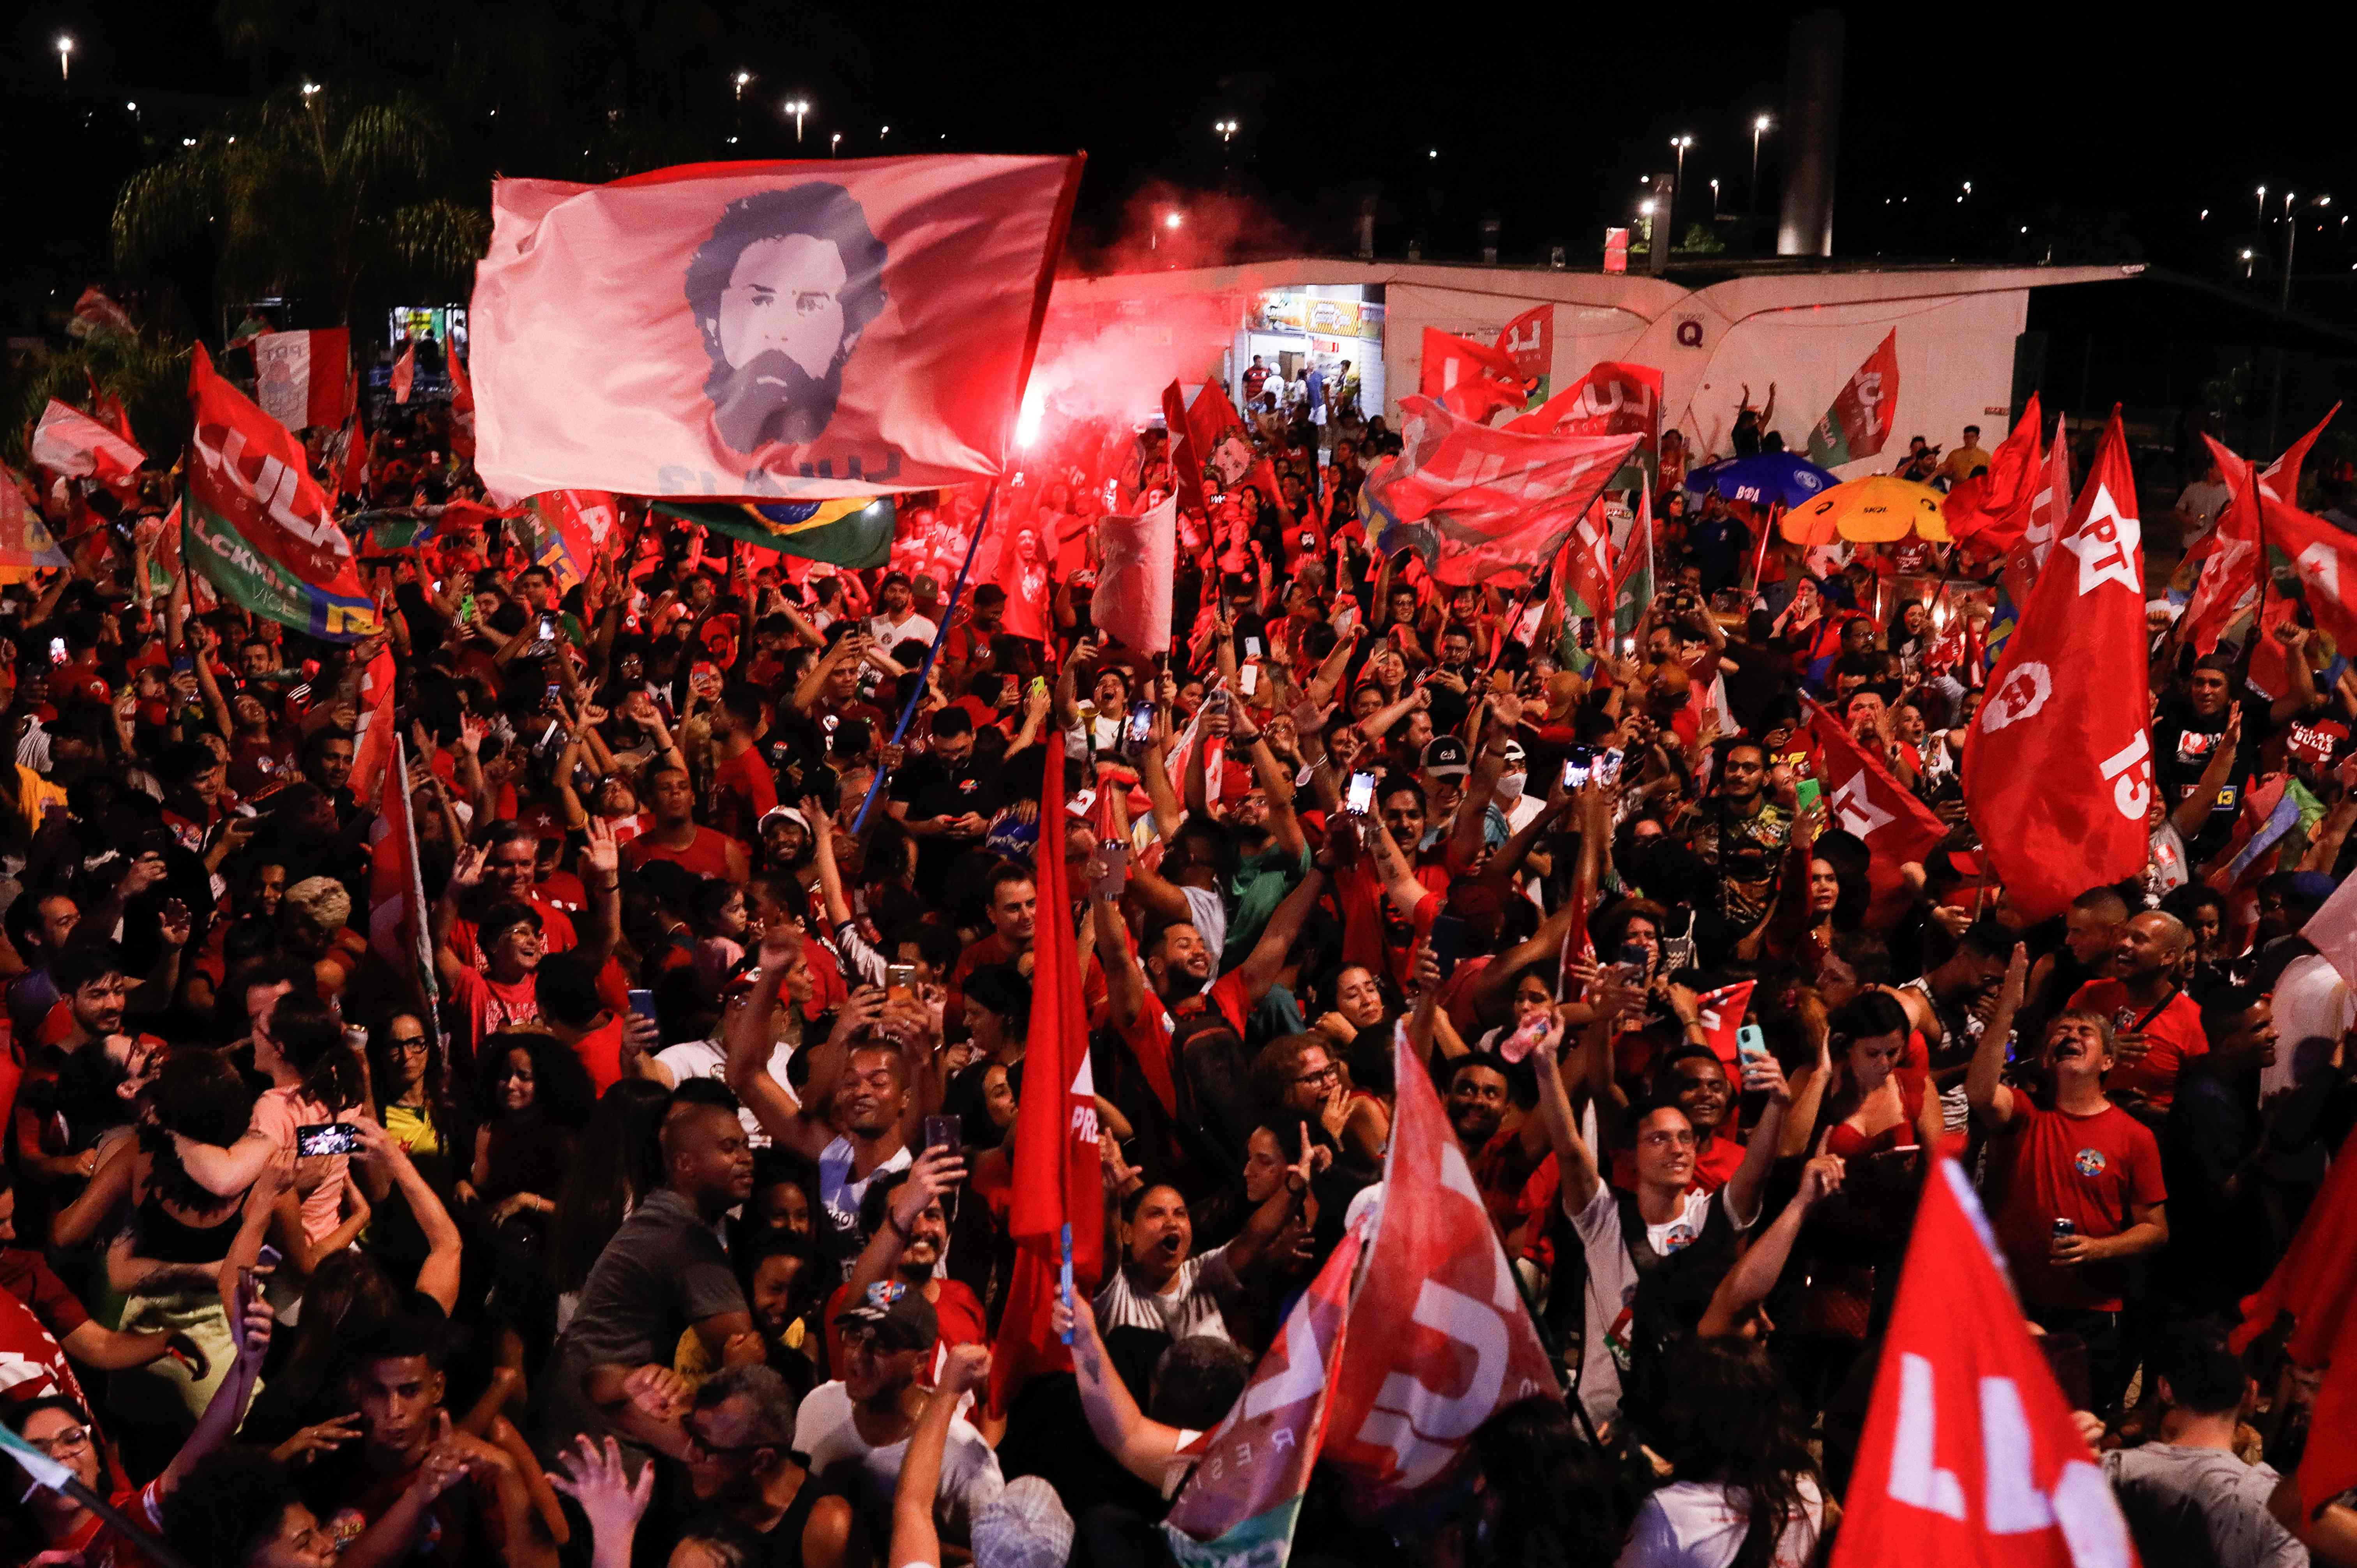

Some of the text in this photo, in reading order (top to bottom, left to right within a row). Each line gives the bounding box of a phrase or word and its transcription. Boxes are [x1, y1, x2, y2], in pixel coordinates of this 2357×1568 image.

[1677, 321, 1703, 348] Q
[2080, 514, 2128, 572] PT
[2294, 730, 2333, 754] BULLS
[2099, 728, 2150, 820] 13
